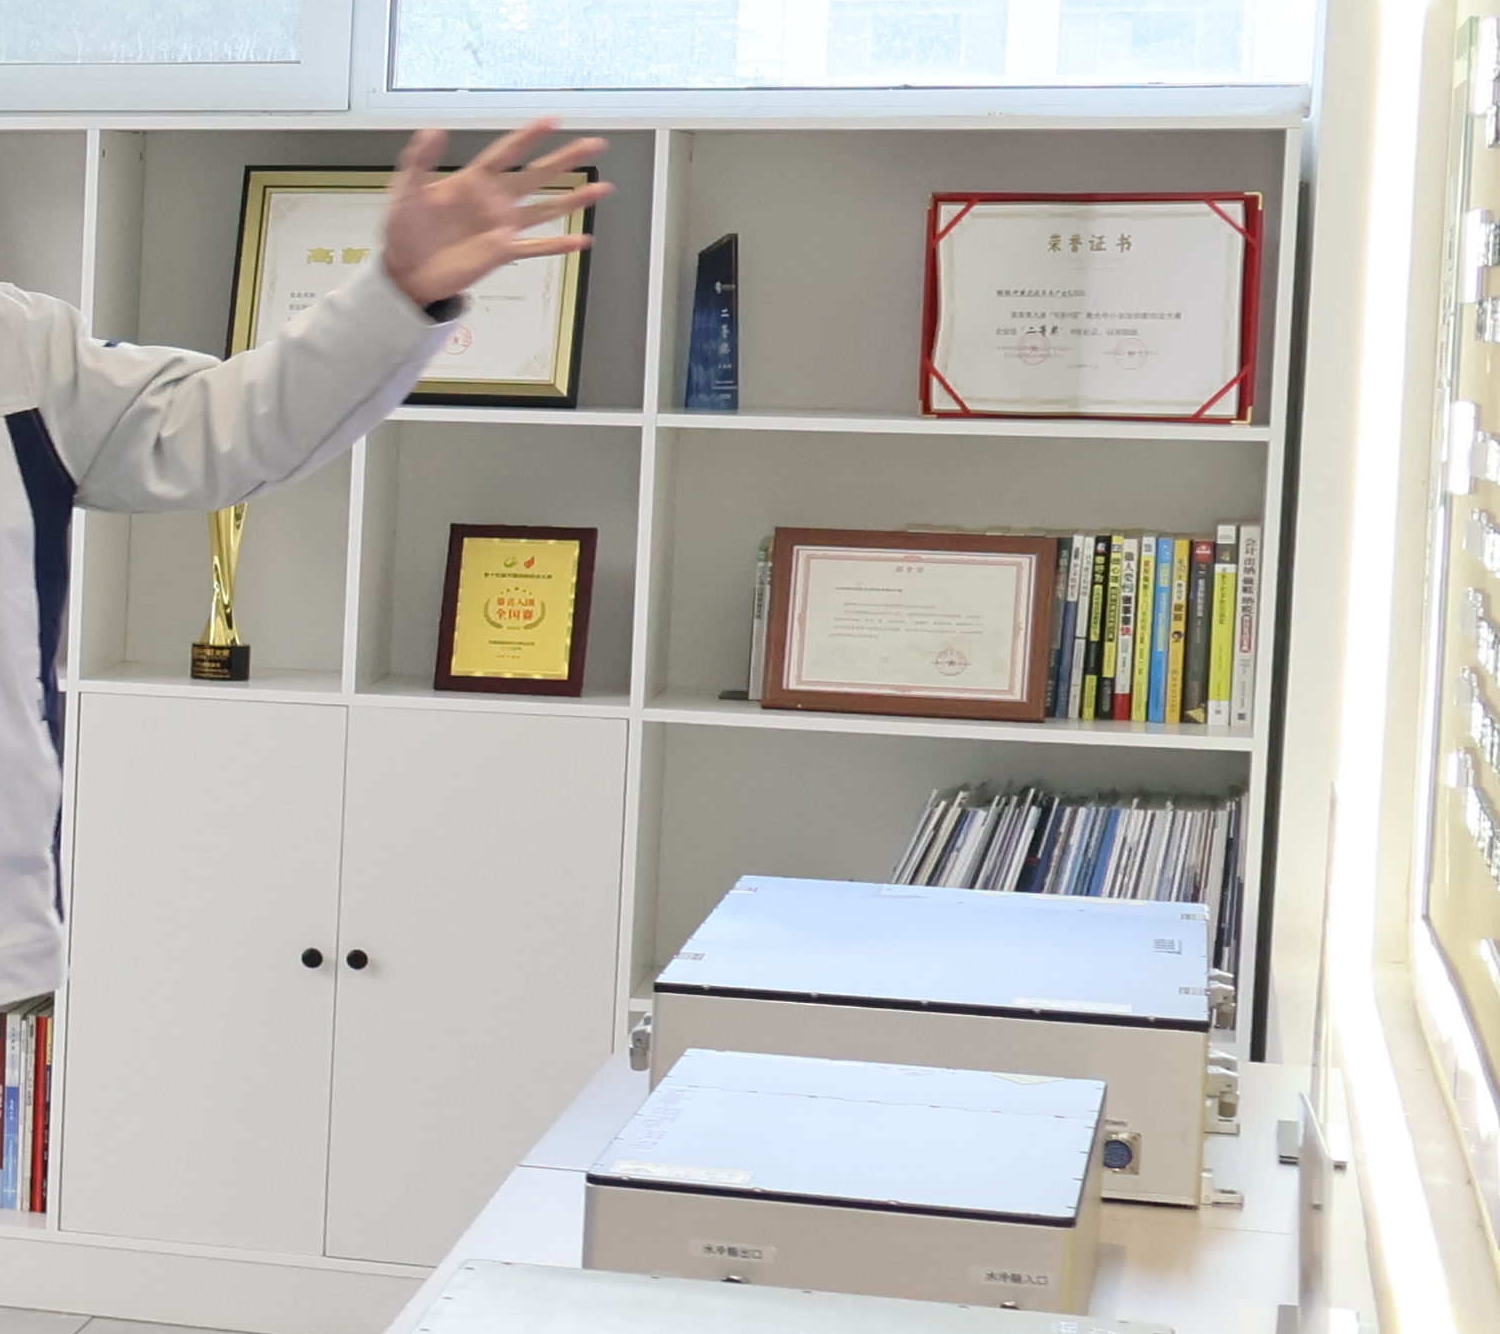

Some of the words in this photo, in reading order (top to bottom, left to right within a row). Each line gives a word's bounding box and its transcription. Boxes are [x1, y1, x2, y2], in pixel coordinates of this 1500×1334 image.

[1047, 233, 1133, 253] 荣誉证书
[496, 608, 534, 621] 全国赛
